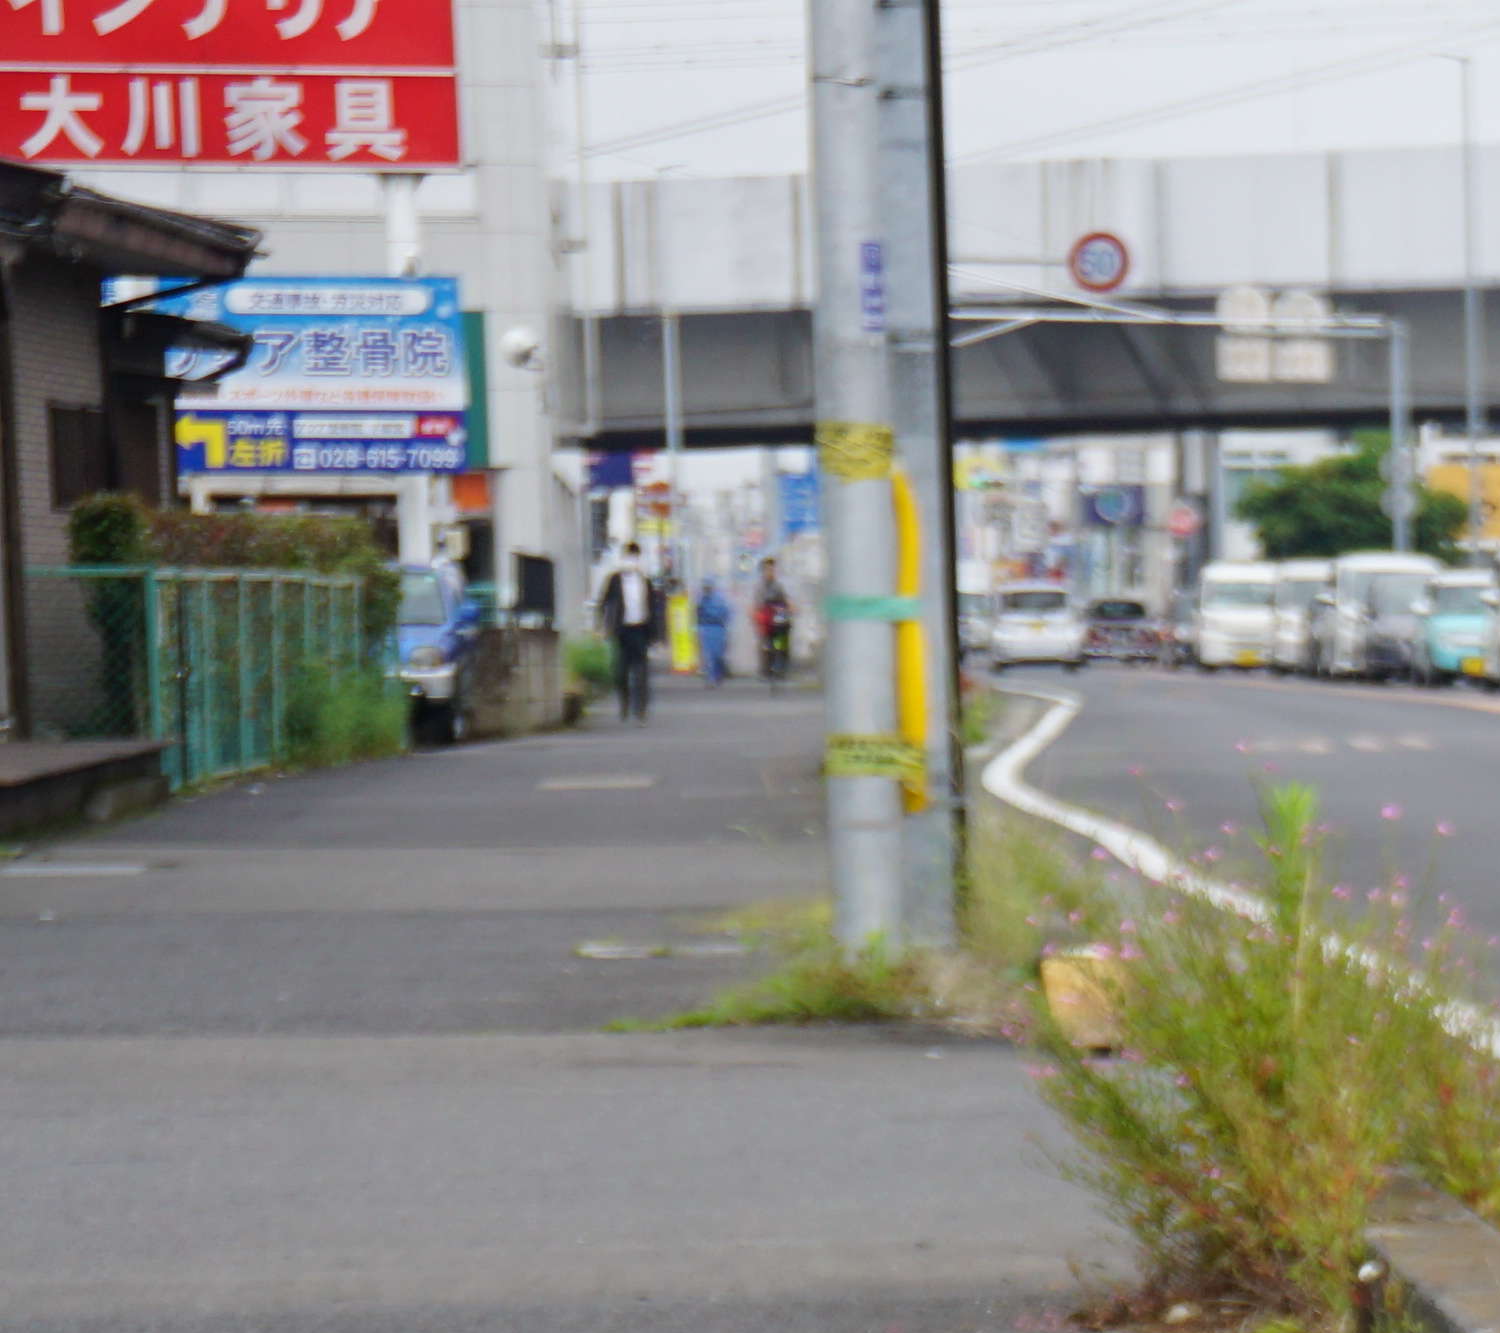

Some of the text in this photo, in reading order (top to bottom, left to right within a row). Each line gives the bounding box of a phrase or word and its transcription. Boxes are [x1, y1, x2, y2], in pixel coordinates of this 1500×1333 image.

[19, 74, 409, 162] 大川家具
[229, 440, 287, 467] 左折
